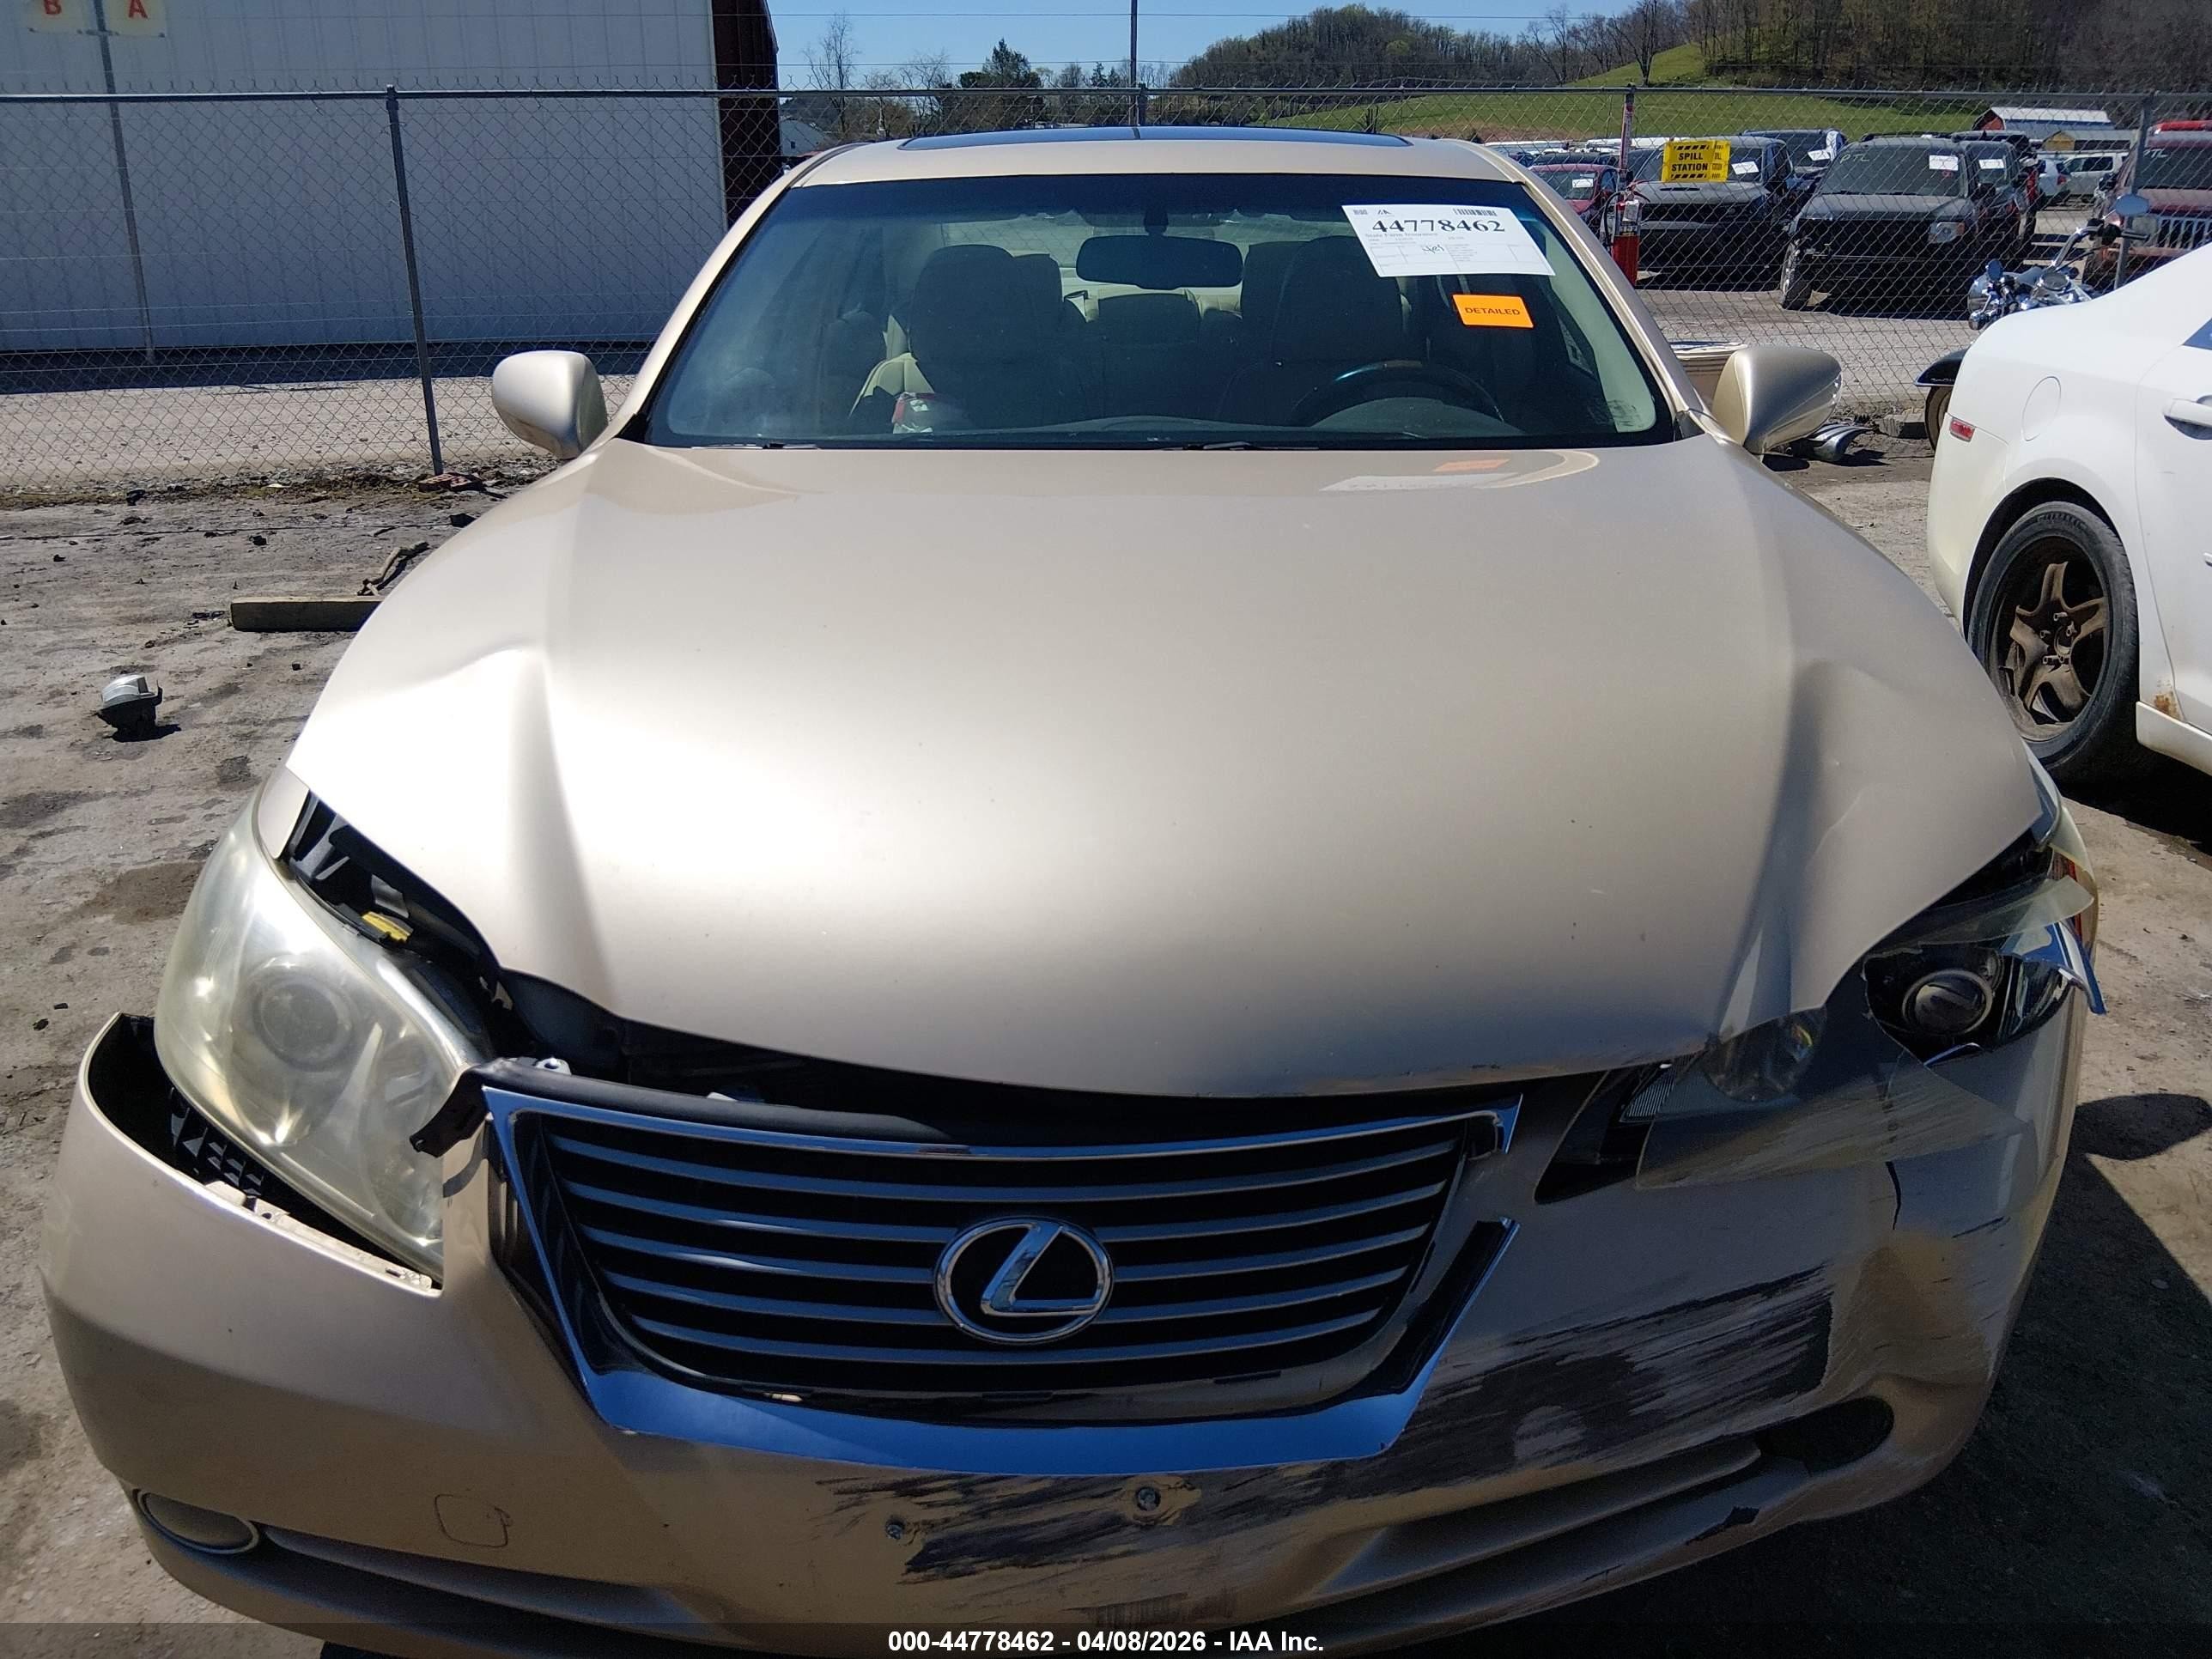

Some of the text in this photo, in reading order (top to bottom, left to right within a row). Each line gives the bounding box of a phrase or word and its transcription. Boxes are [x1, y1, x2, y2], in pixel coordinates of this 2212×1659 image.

[127, 0, 149, 19] A
[1679, 152, 1704, 161] SPILL
[1671, 162, 1709, 172] STATION
[1371, 219, 1505, 233] 44778462
[1464, 307, 1522, 316] DETAILED
